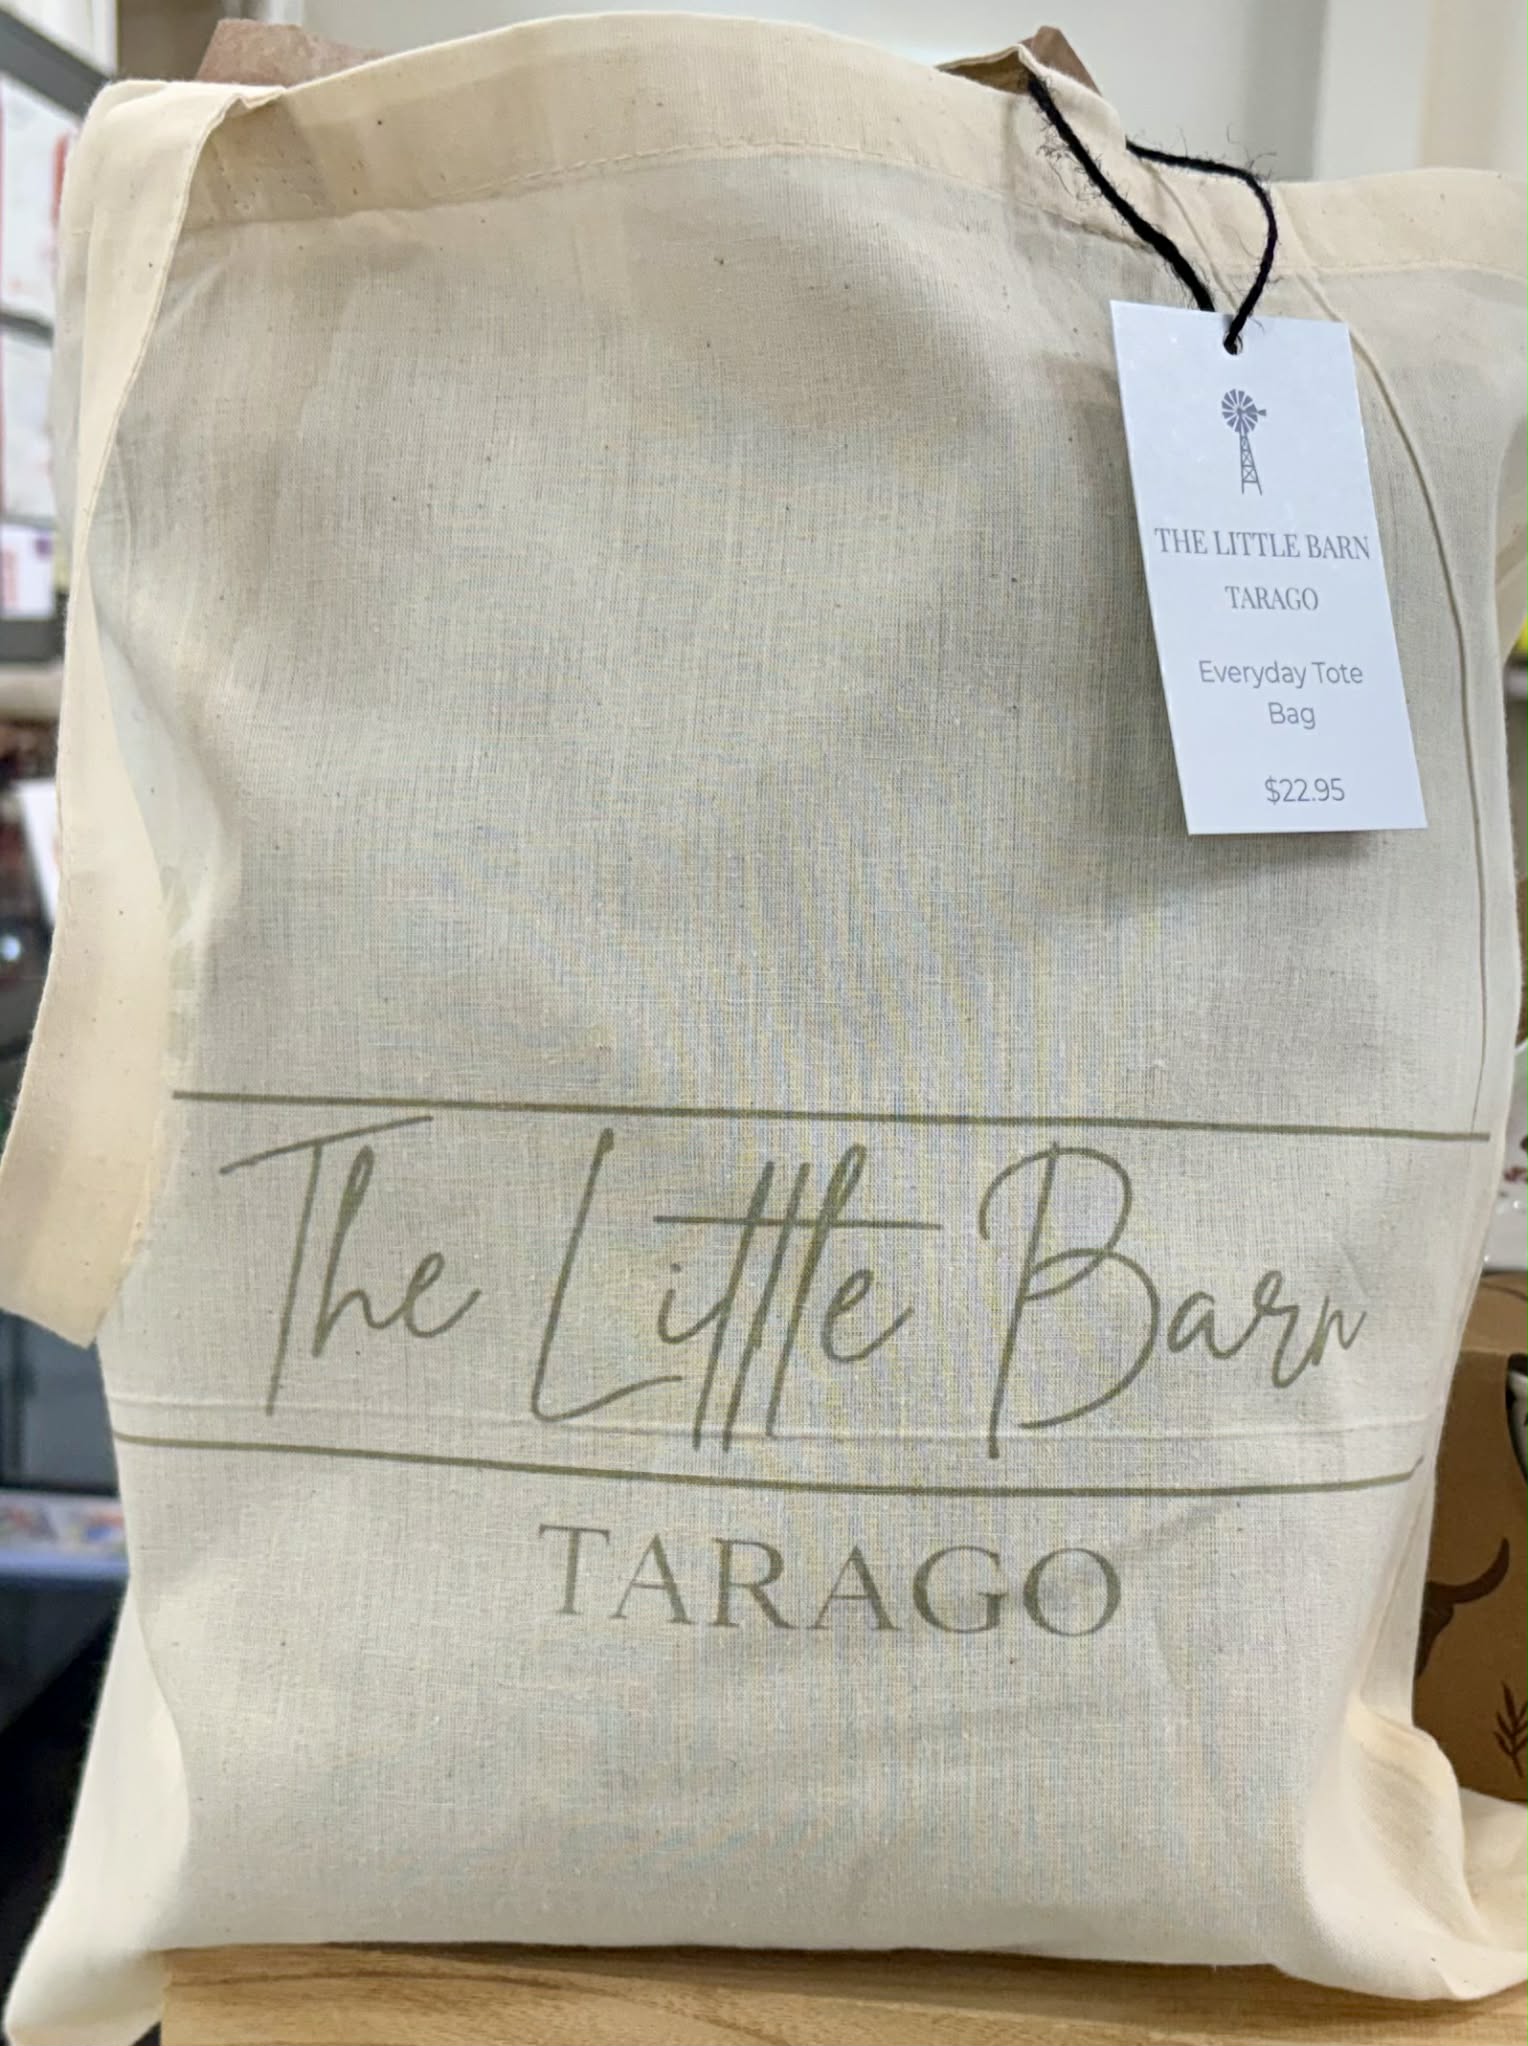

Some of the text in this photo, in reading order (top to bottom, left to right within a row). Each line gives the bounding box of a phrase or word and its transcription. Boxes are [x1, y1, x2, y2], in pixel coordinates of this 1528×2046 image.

[1154, 527, 1371, 560] THE LITTLE BARN
[1224, 586, 1319, 611] TARAGO
[1199, 660, 1364, 689] Everyday Tote
[1267, 702, 1317, 730] Bag
[1264, 776, 1346, 805] $22.95
[219, 1115, 1368, 1460] The Little Barn
[538, 1523, 1122, 1638] TARAGO
